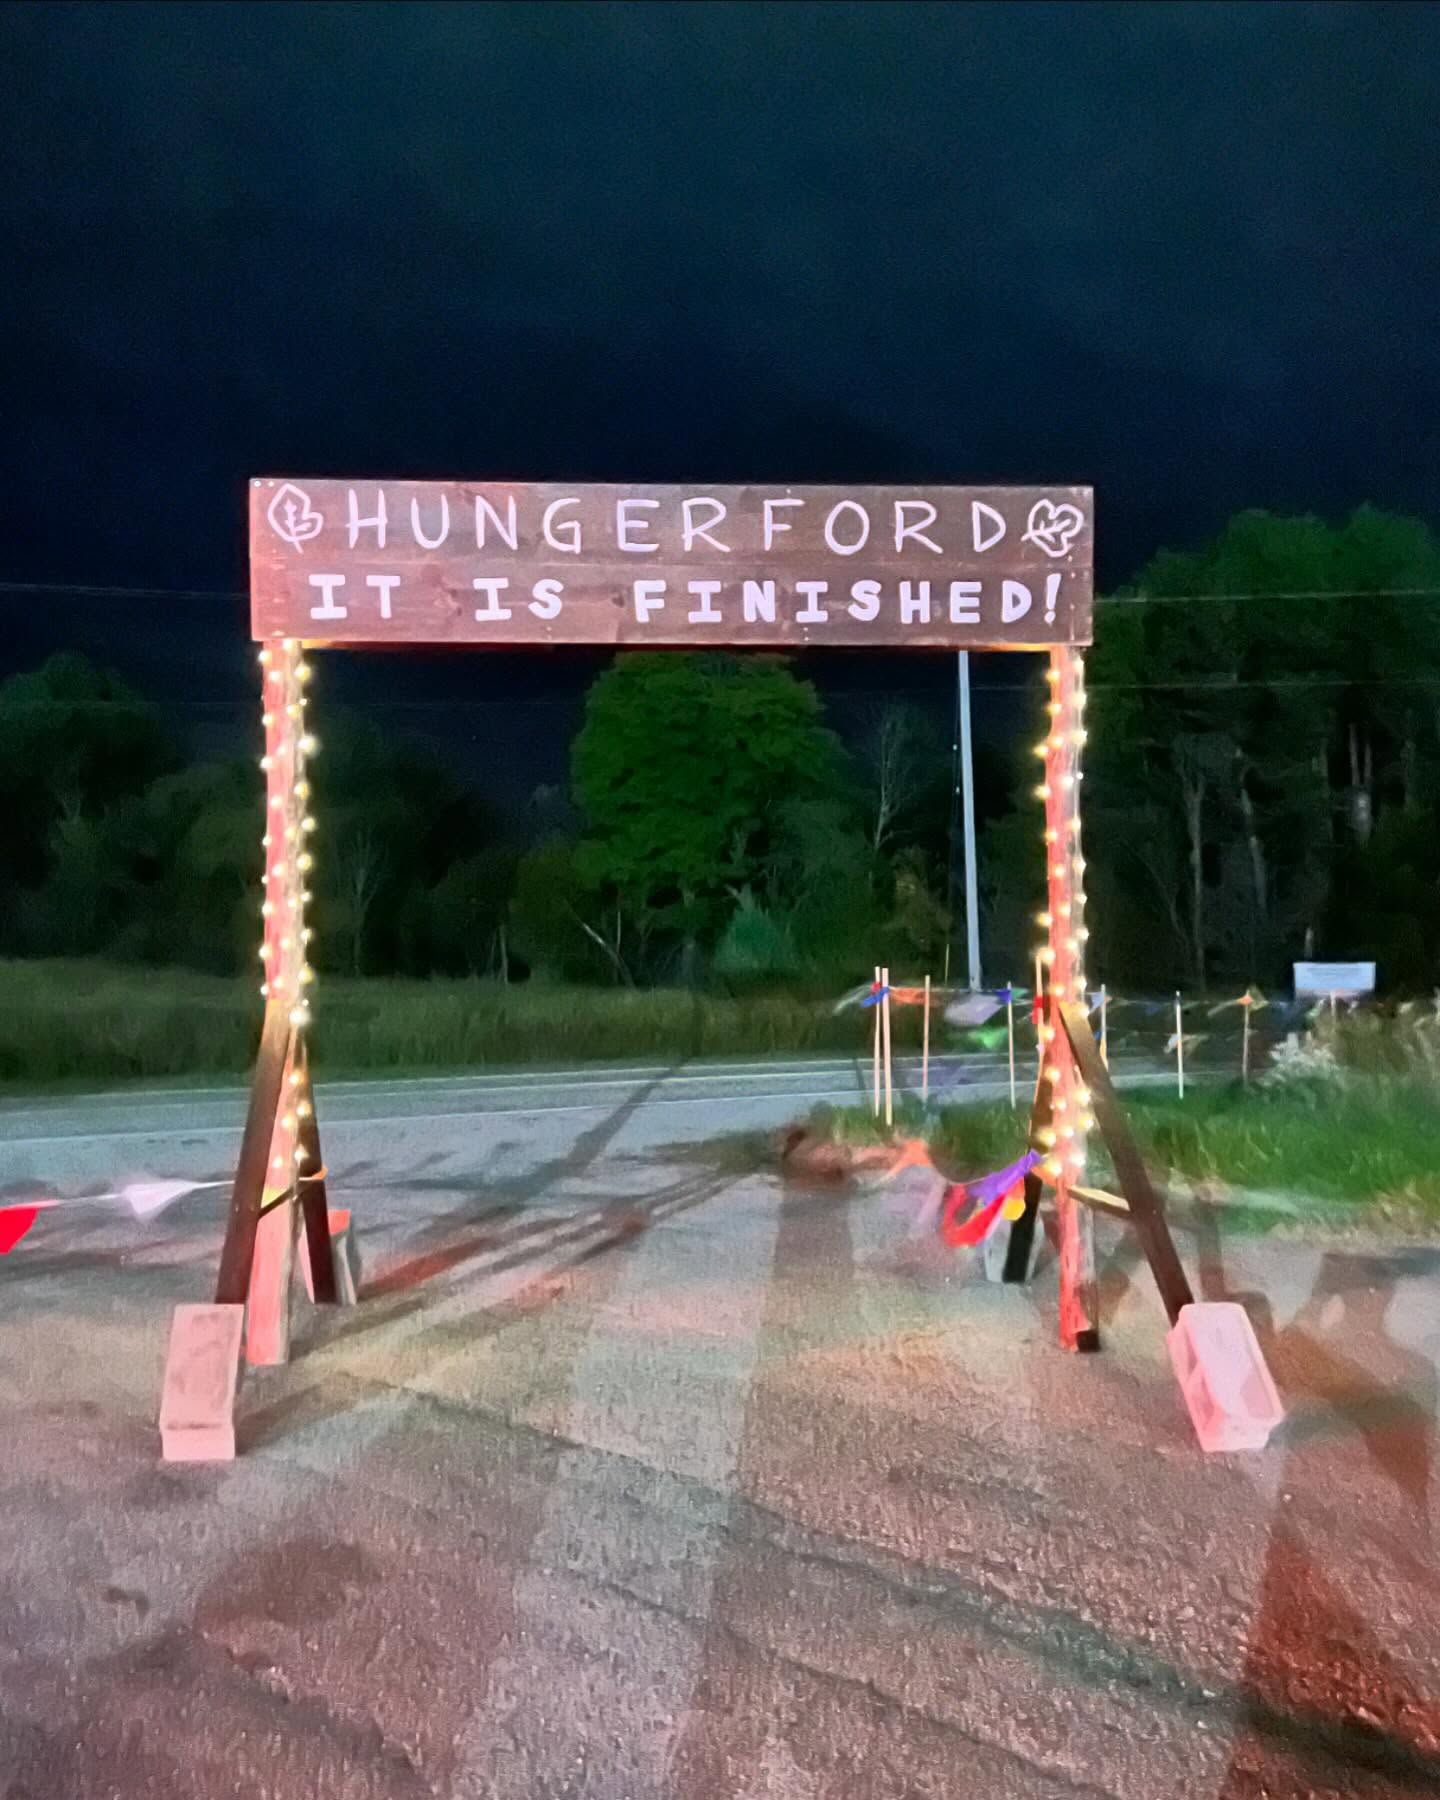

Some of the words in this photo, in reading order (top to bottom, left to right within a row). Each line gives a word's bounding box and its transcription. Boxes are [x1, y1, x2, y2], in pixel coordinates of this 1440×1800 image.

[345, 488, 1007, 555] HUNGERFORD
[308, 573, 401, 620] IT
[472, 577, 565, 621] IS
[633, 573, 1062, 624] FINISHED!
